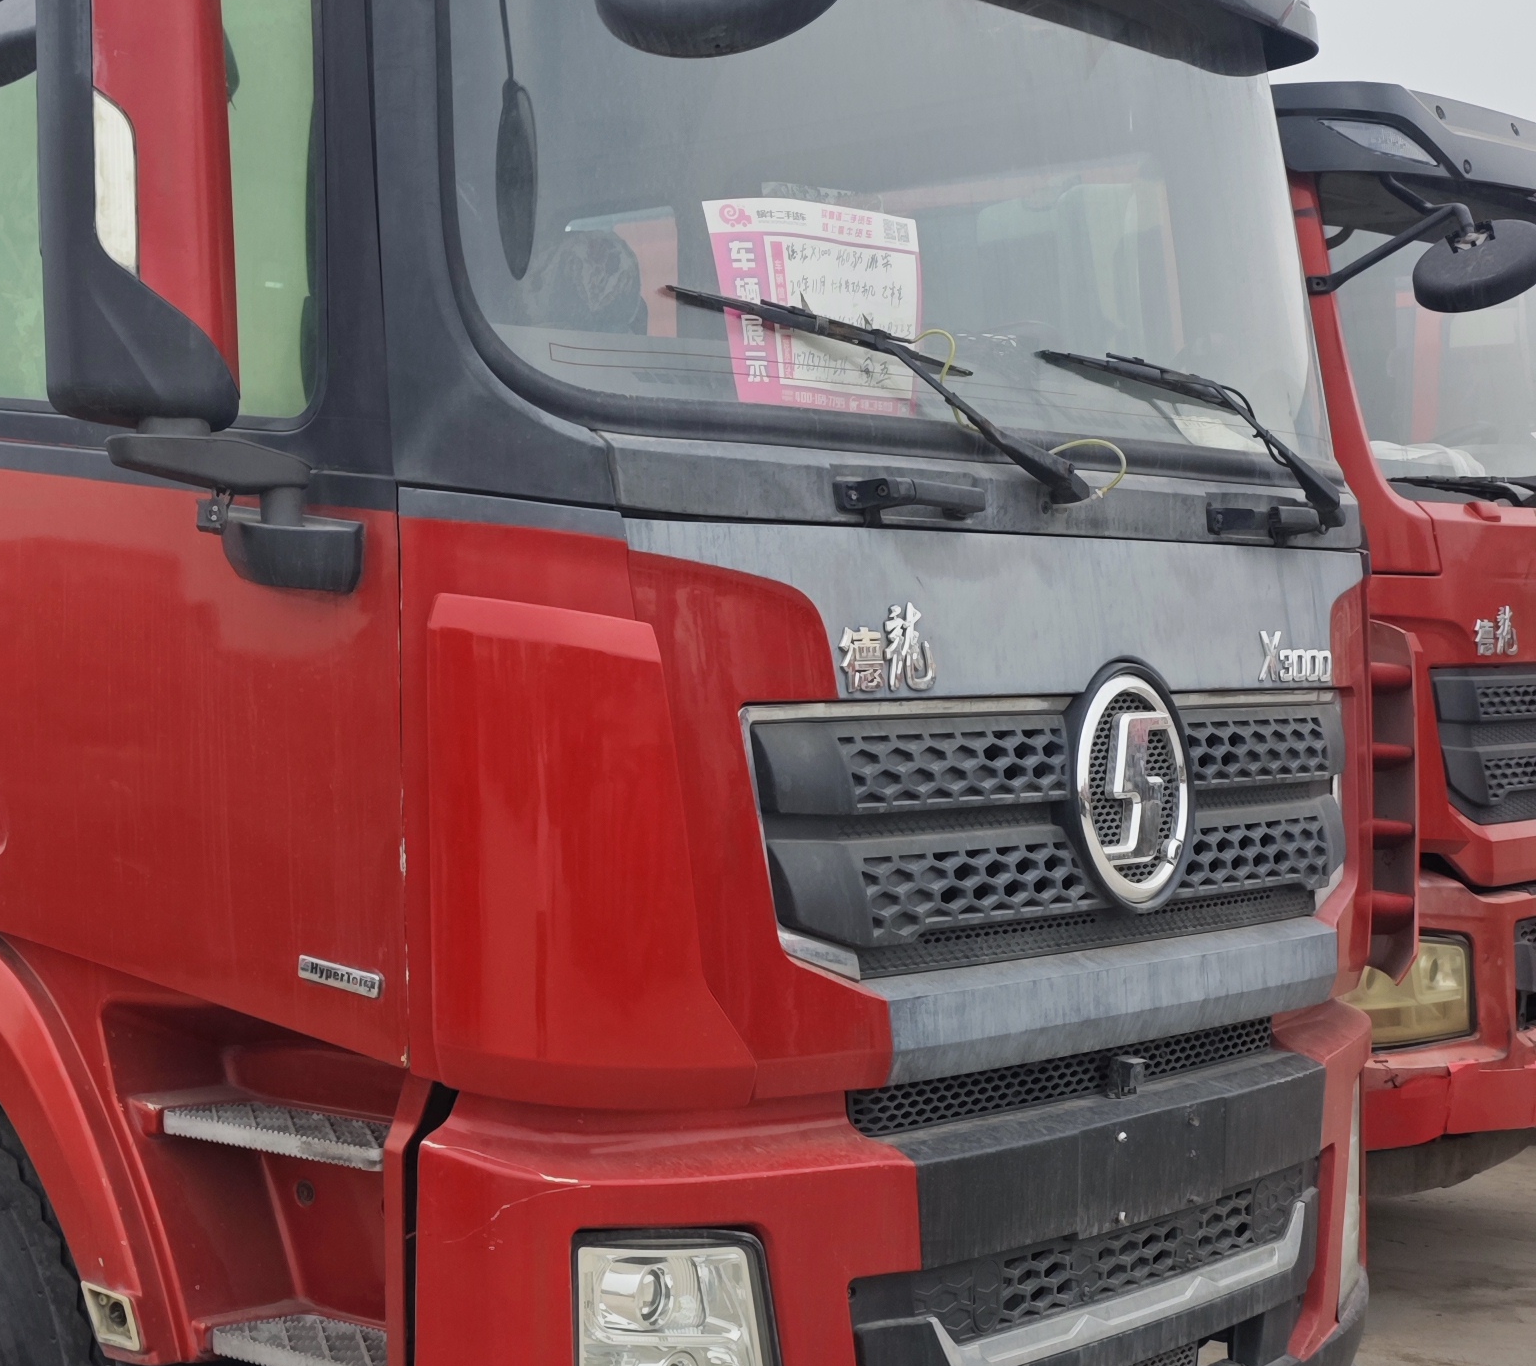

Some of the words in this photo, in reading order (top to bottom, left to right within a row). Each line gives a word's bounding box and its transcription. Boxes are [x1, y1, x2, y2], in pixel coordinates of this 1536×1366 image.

[728, 240, 770, 383] 车辆展示
[1257, 629, 1333, 683] X3000
